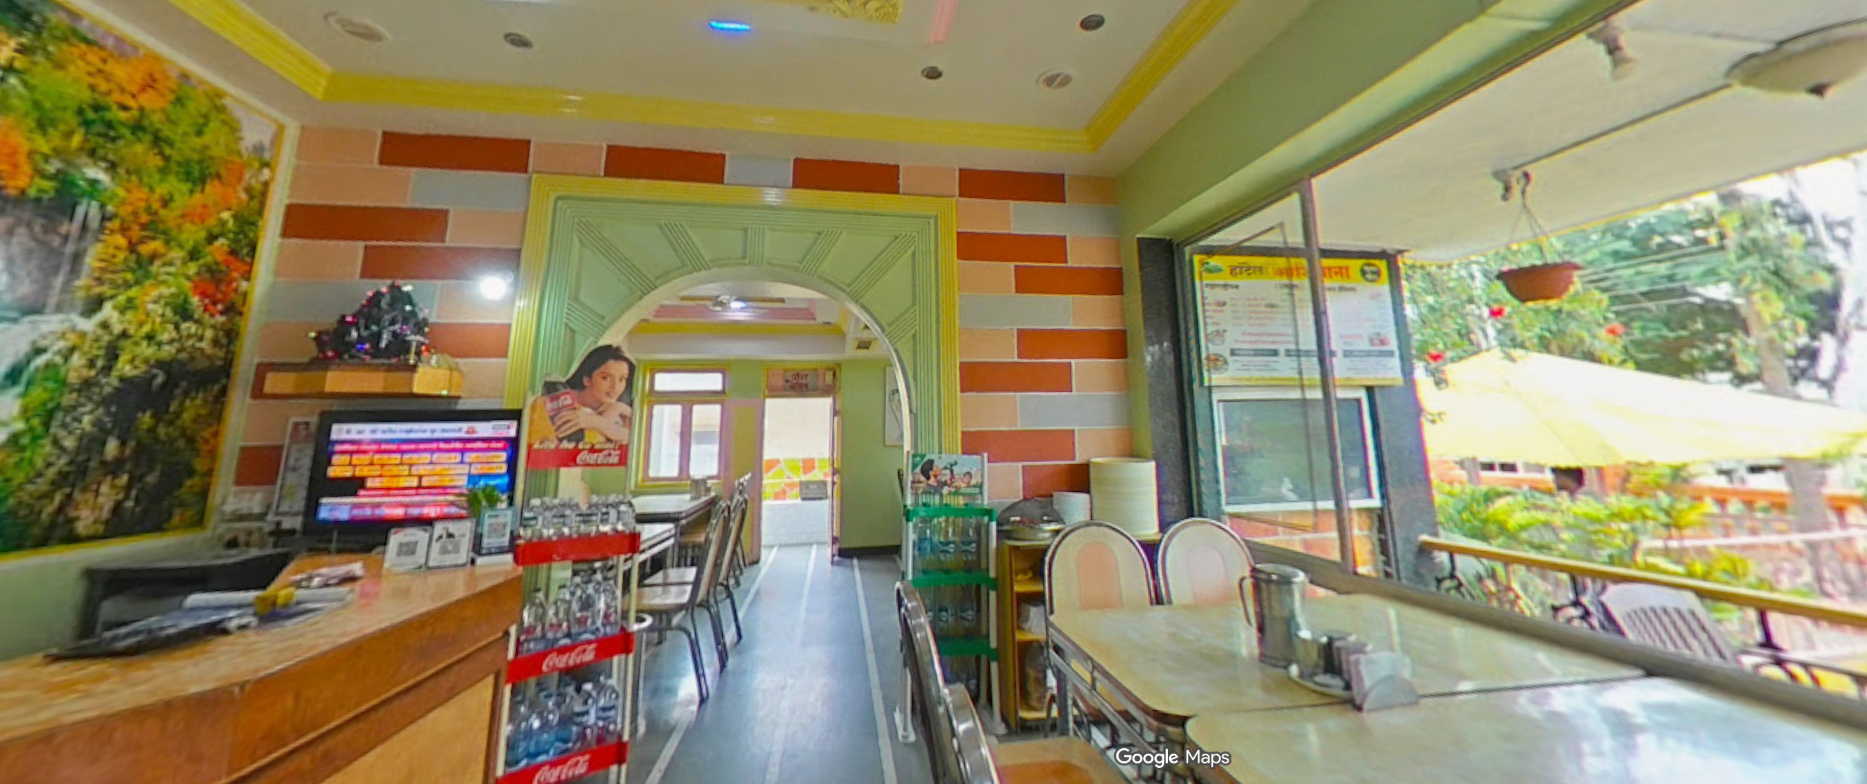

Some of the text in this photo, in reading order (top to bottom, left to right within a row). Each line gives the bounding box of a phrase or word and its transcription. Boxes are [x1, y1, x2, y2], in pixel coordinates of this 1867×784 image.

[576, 450, 621, 465] Coca-Cola
[542, 643, 597, 672] Coca-Cola
[532, 754, 591, 784] Coca-Cola
